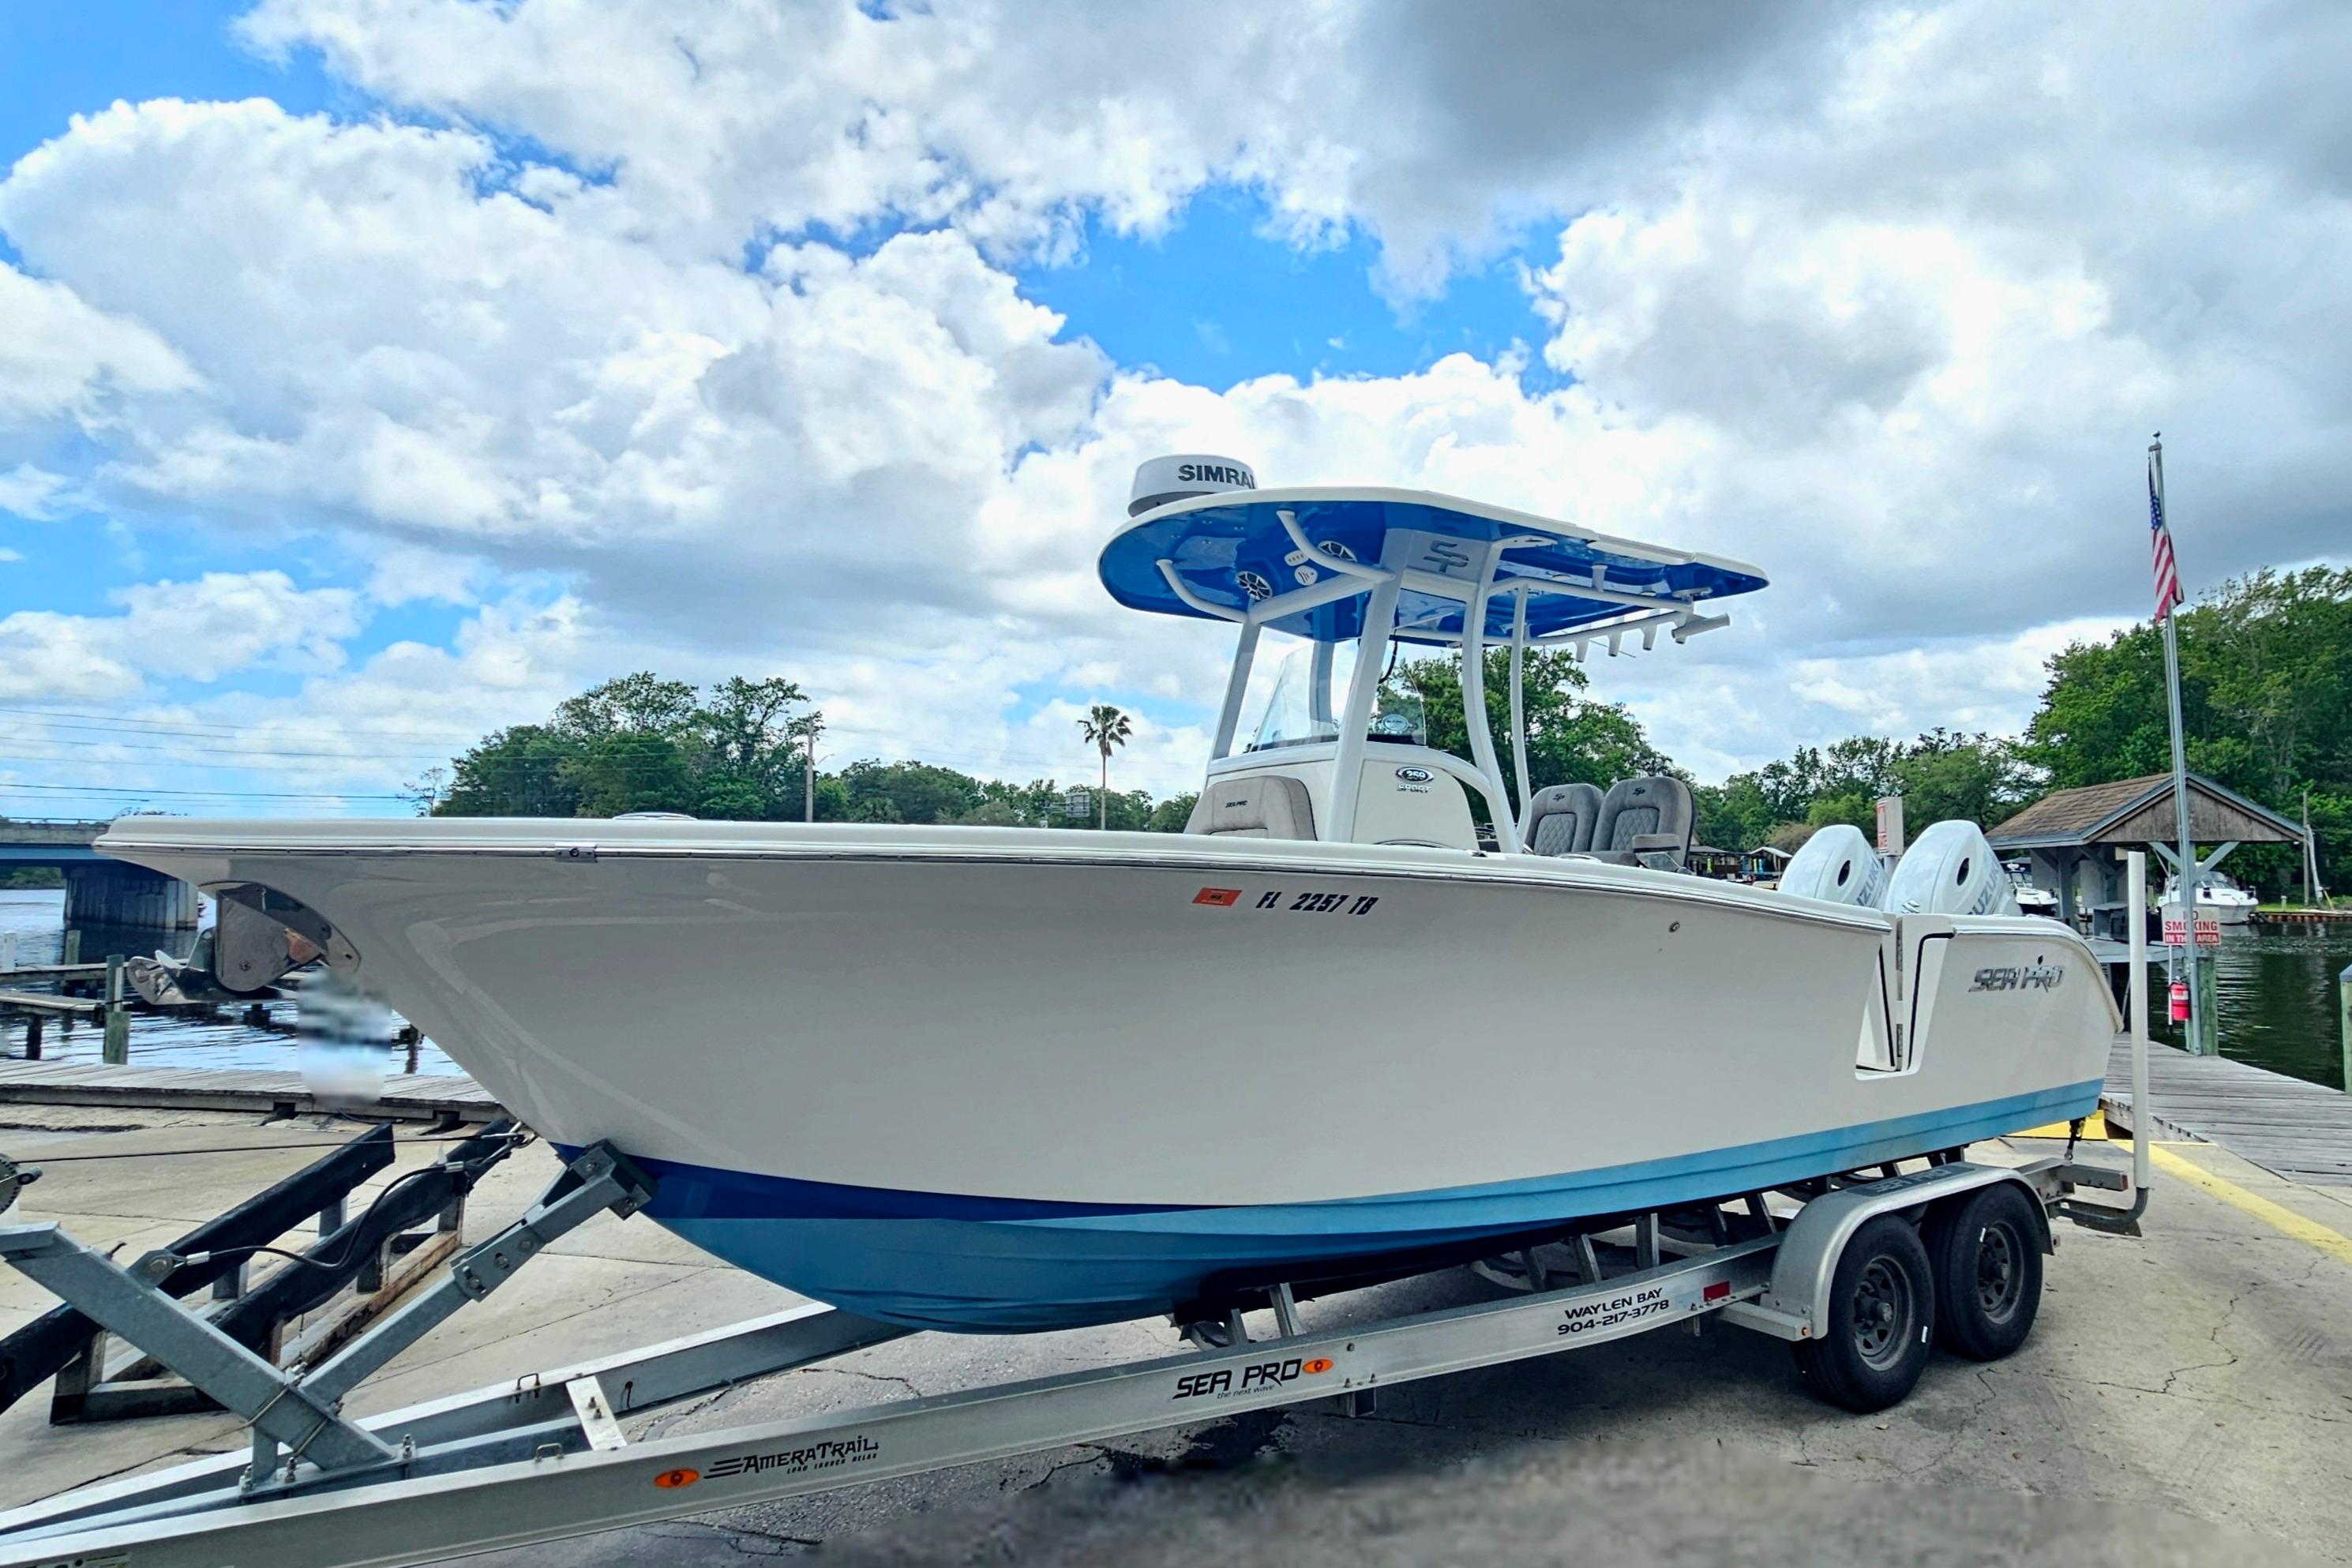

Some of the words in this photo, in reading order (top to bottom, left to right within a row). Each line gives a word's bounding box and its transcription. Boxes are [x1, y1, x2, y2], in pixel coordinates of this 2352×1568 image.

[1397, 783, 1432, 793] SPORT
[1255, 891, 1282, 909] FL
[1289, 892, 1349, 913] 2257
[1348, 896, 1379, 915] TB
[2196, 934, 2218, 943] AREA
[1565, 1296, 1632, 1319] WAYLEN
[1637, 1288, 1663, 1304] BAY
[1557, 1300, 1670, 1335] 904-217-3778
[1172, 1370, 1232, 1400] SEA
[1242, 1359, 1302, 1388] PRO
